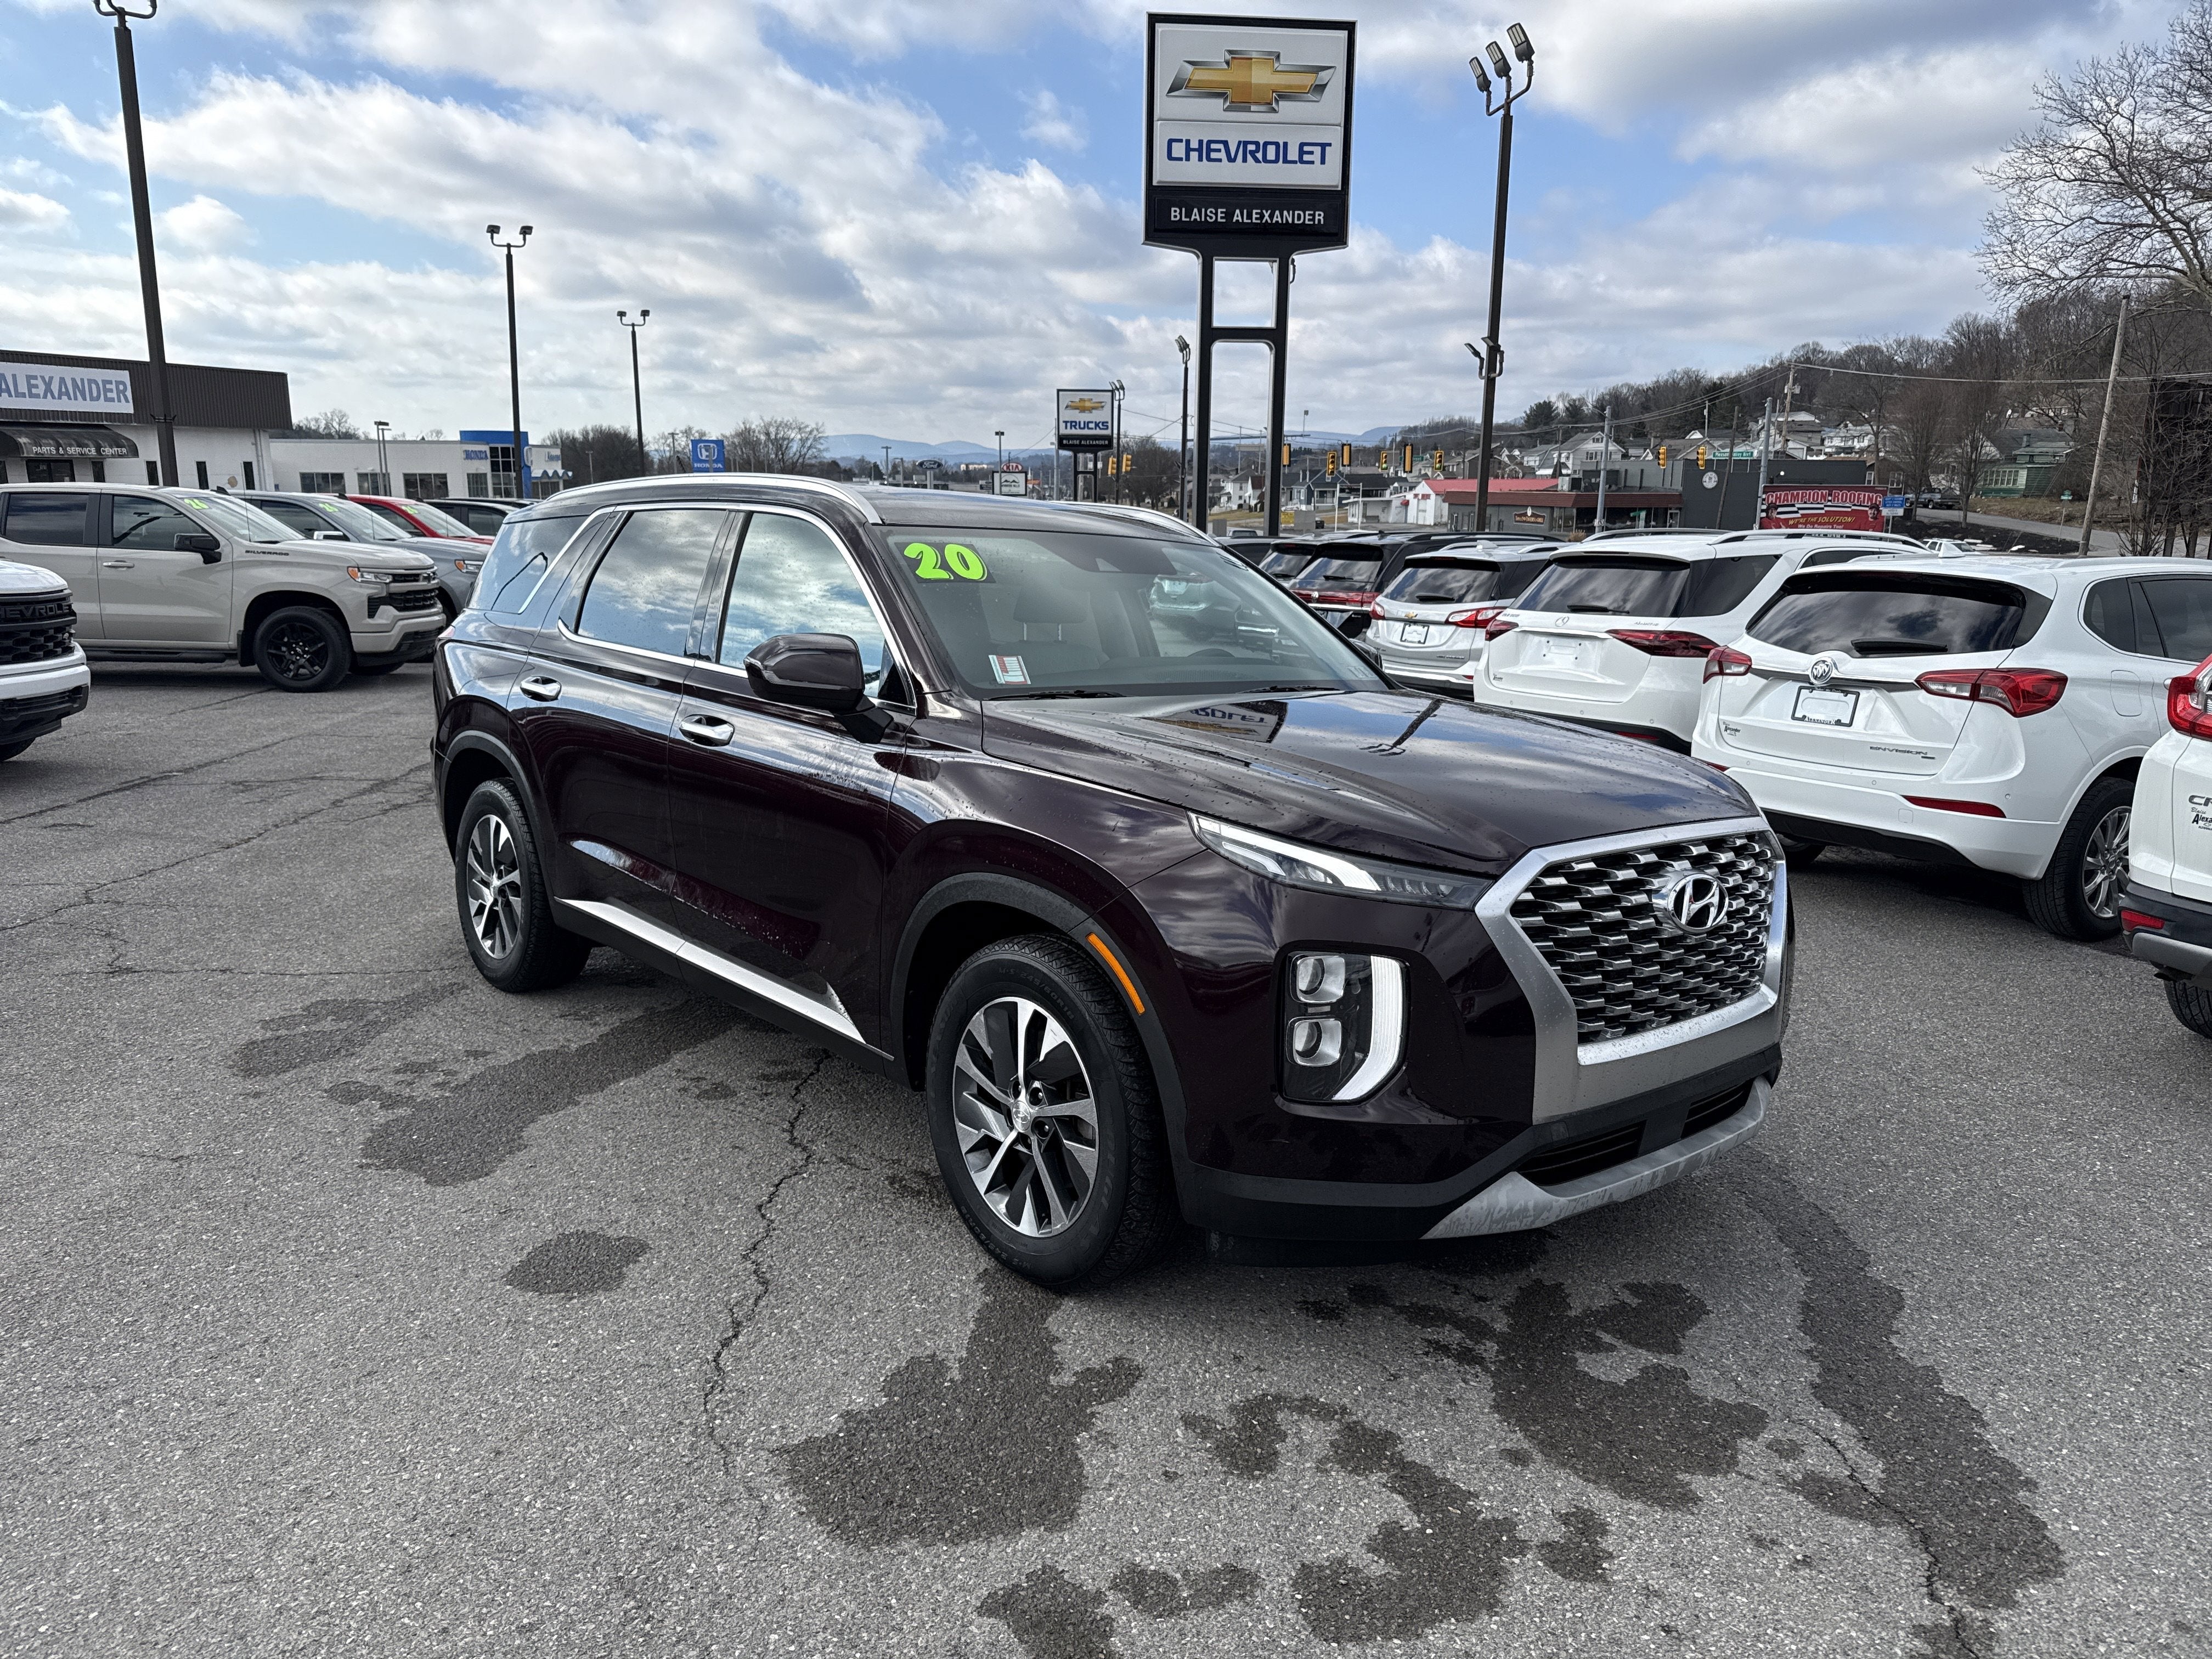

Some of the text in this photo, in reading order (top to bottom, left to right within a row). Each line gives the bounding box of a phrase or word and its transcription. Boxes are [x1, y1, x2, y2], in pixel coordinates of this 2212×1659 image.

[1166, 138, 1332, 165] CHEVROLET
[1170, 207, 1325, 225] BLAISE ALEXANDER
[0, 372, 131, 404] ALEXANDER
[1062, 420, 1109, 431] TRUCKS
[32, 446, 56, 454] PARTS
[66, 447, 97, 455] SERVICE
[465, 449, 489, 461] HONDA
[1765, 489, 1883, 507] CHAMPION ROOFING
[904, 542, 988, 582] 20
[1804, 716, 1836, 725] ALEXANDER
[1870, 746, 1928, 755] ENVISION
[2191, 806, 2207, 815] Blaise
